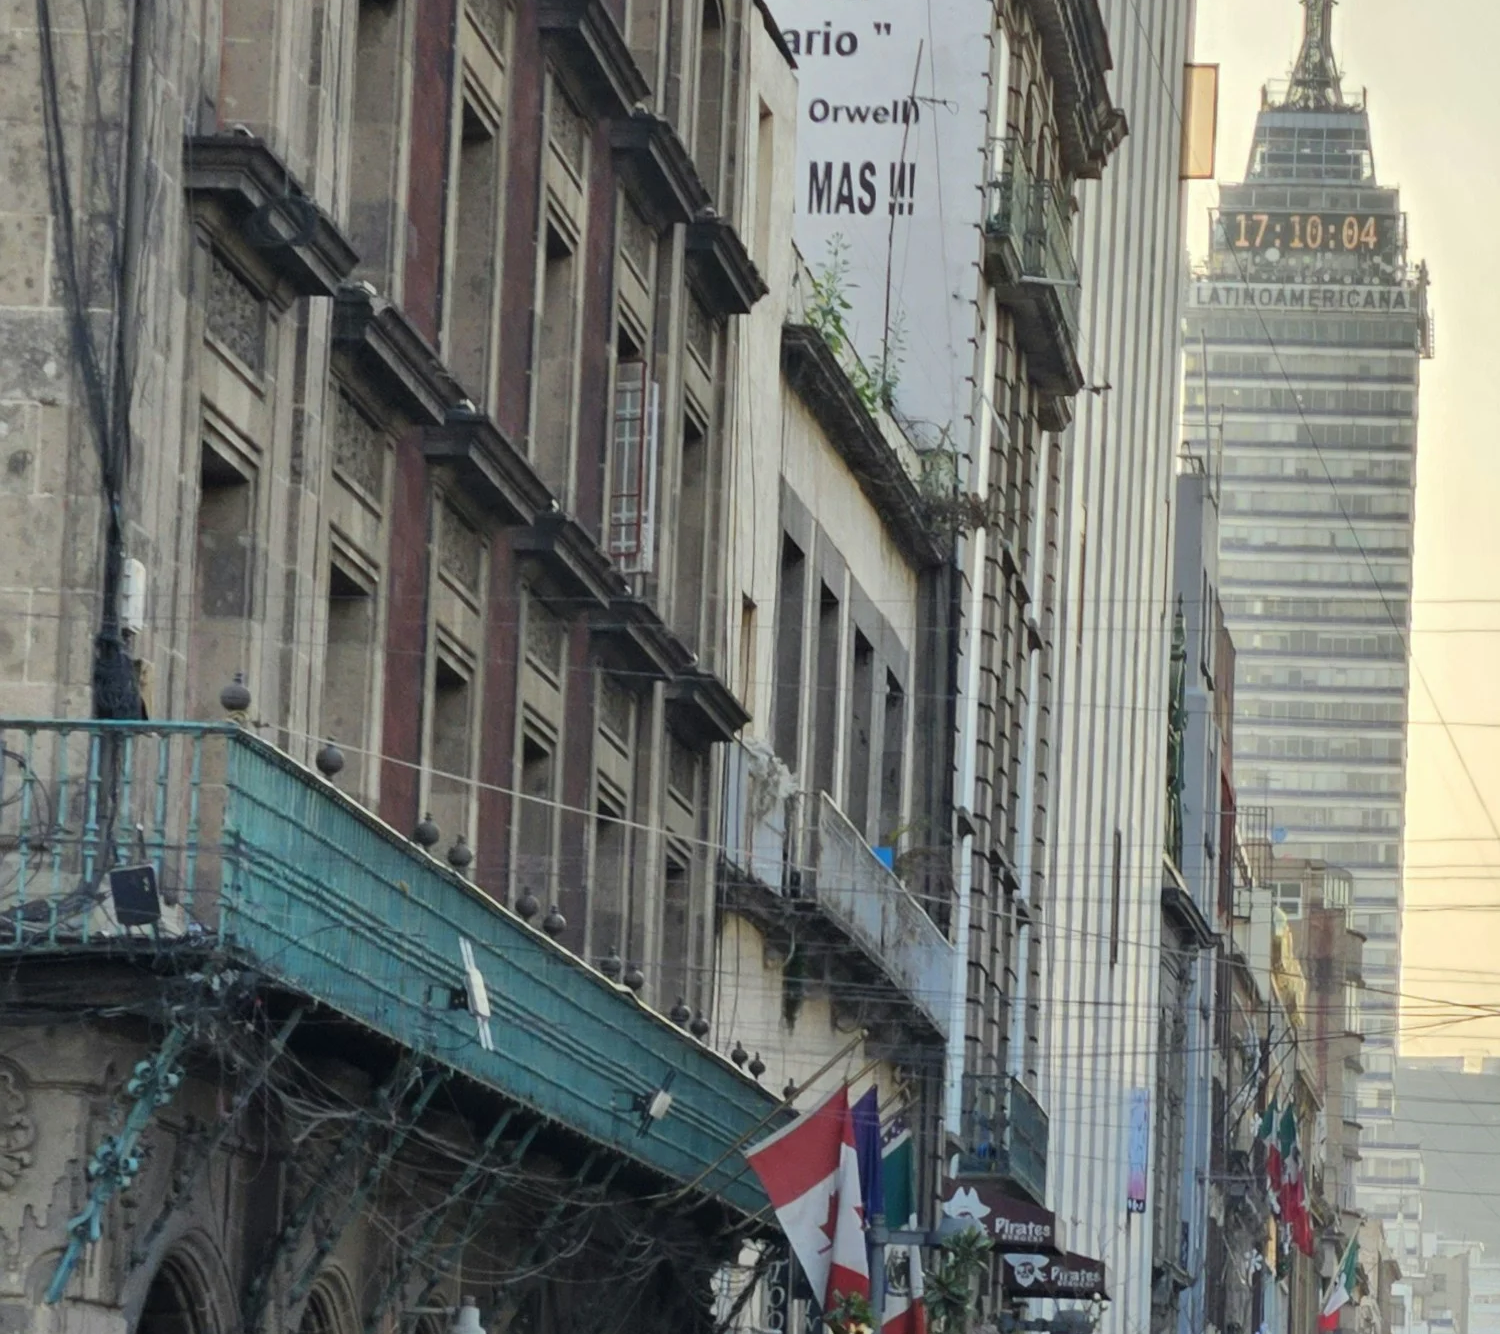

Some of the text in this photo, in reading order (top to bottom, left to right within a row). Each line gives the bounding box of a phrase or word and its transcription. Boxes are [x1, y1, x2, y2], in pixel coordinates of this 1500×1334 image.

[782, 21, 858, 57] ario
[808, 161, 877, 215] MAS
[1235, 215, 1378, 249] 17:10:04
[1196, 287, 1408, 310] LATINOAMERICANA
